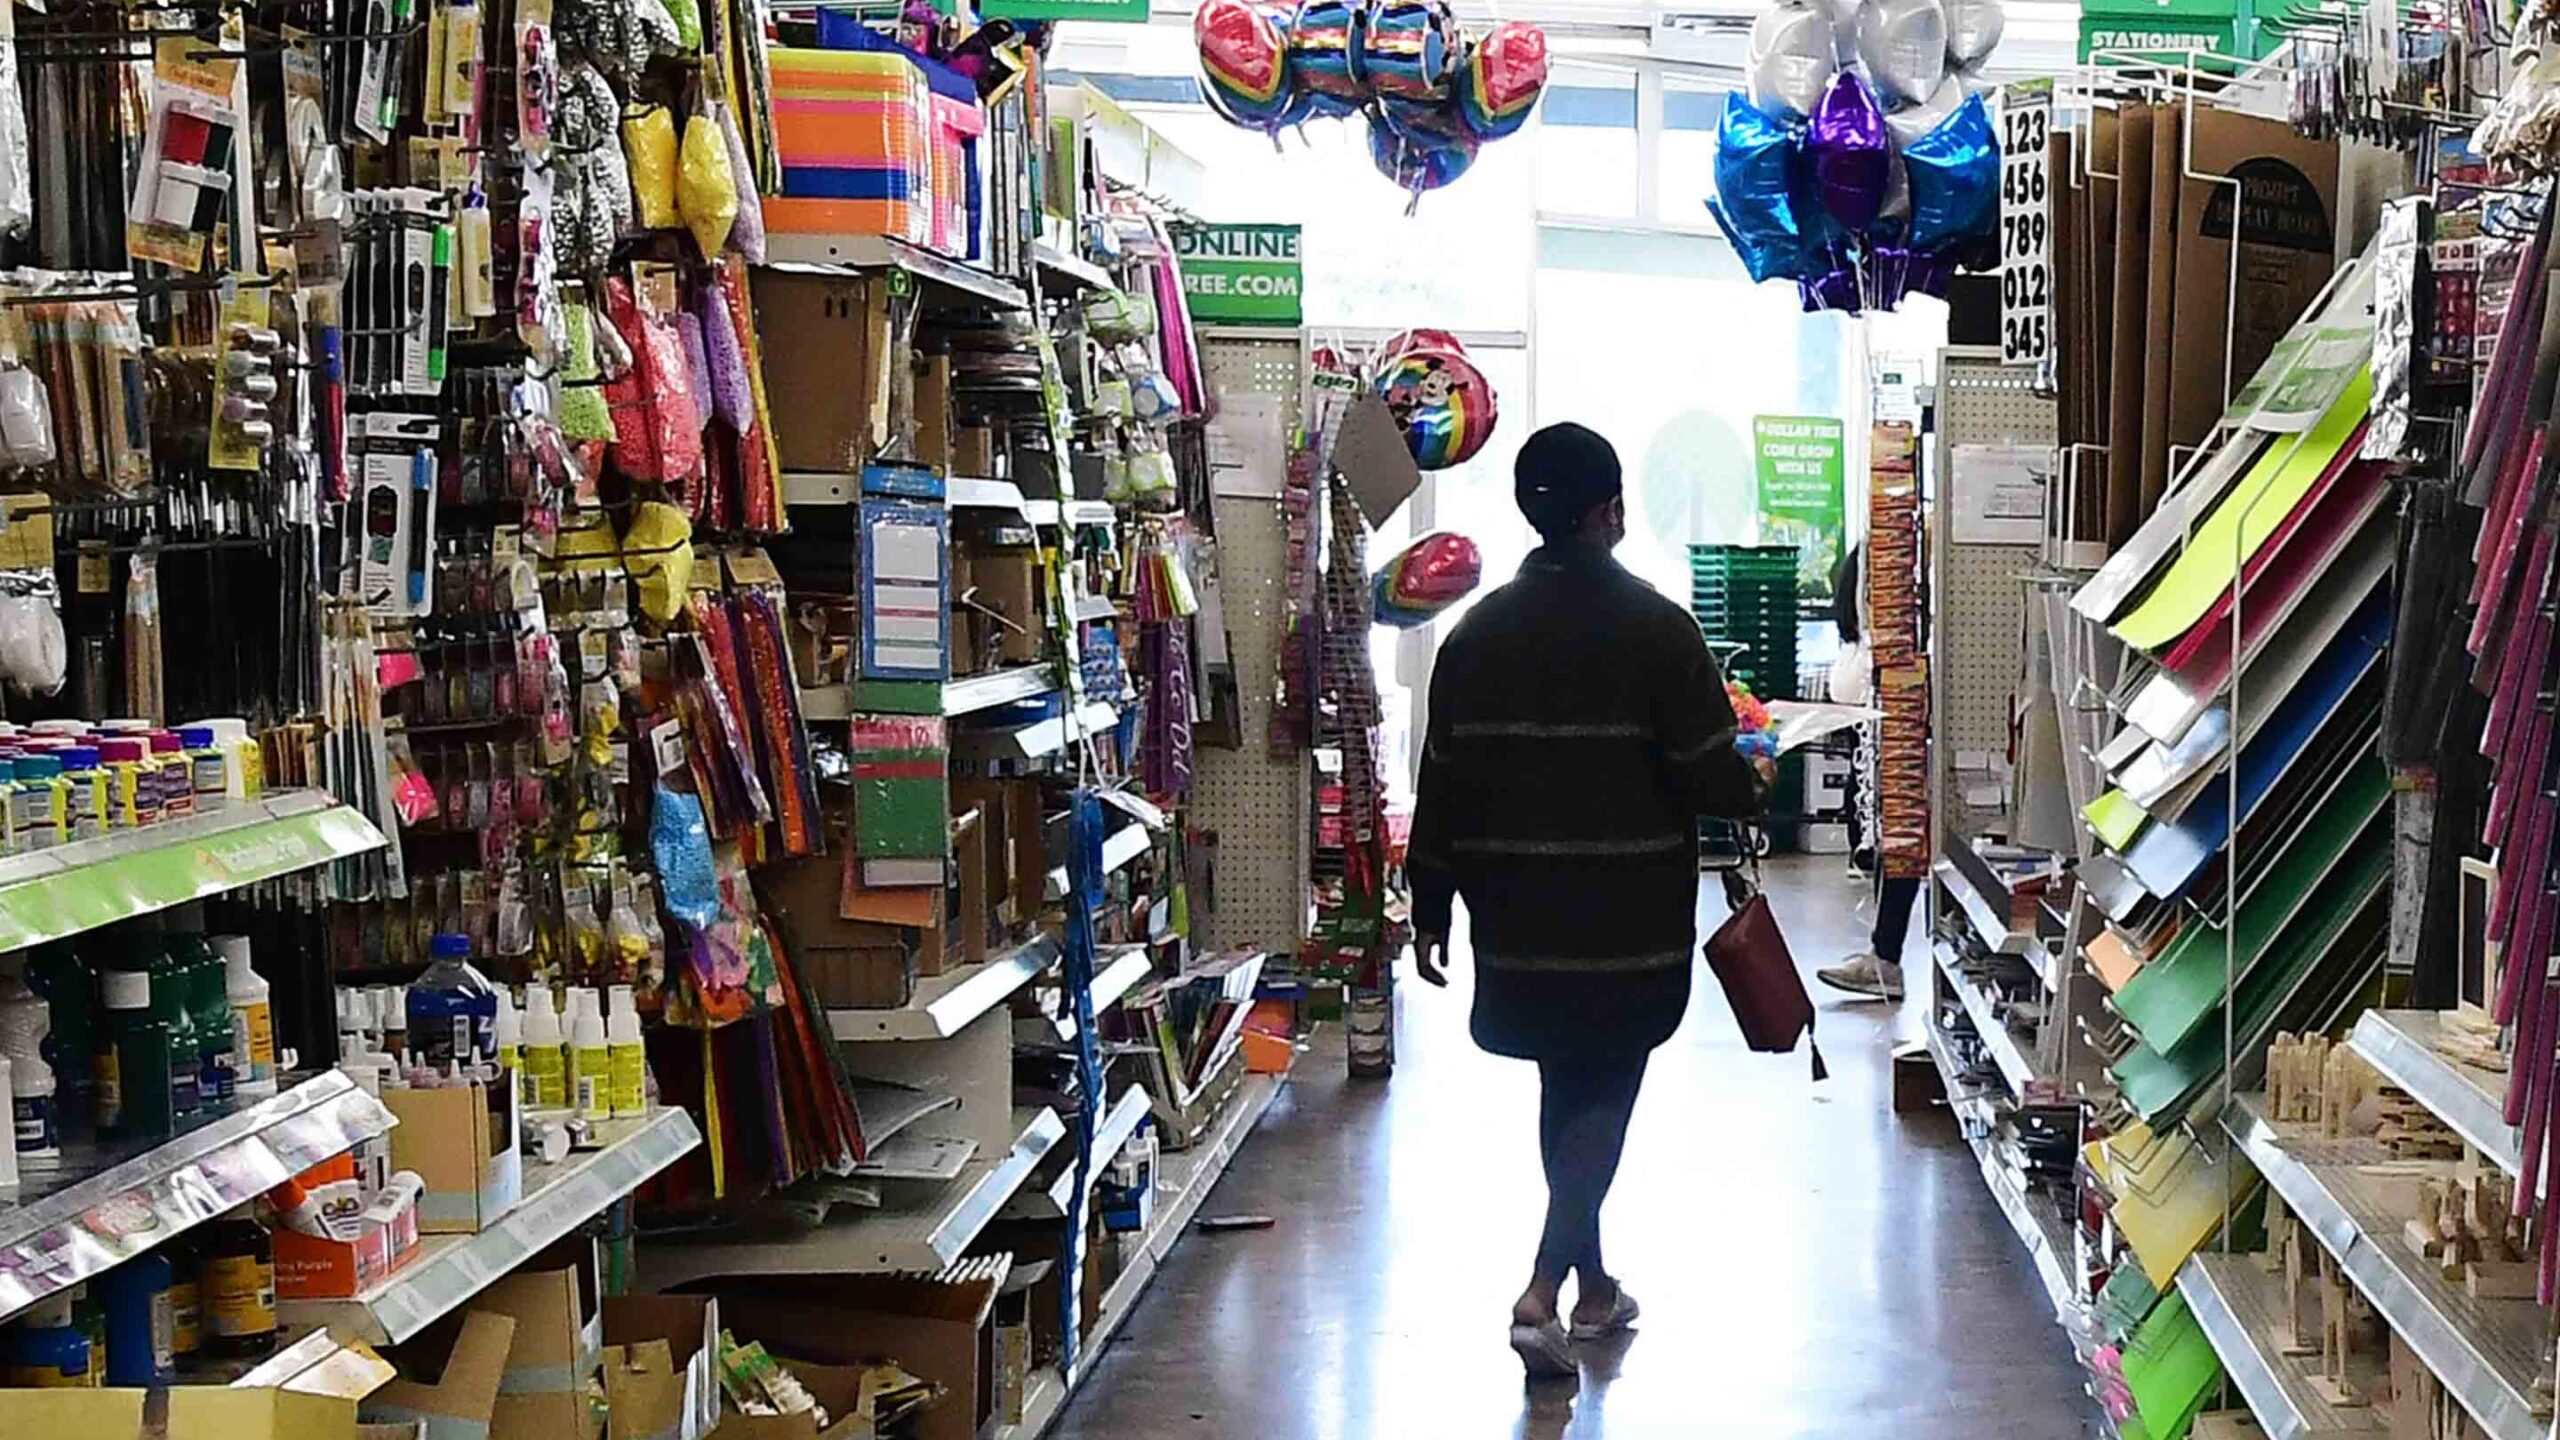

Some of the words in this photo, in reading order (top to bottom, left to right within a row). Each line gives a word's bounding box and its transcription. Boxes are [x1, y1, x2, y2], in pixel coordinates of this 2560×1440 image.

[2091, 31, 2220, 50] STATIONERY
[2004, 110, 2046, 156] 123
[2003, 160, 2046, 205] 456
[1177, 230, 1297, 257] ONLINE
[2003, 212, 2046, 259] 789
[2003, 264, 2046, 310] 012
[2004, 315, 2046, 361] 345
